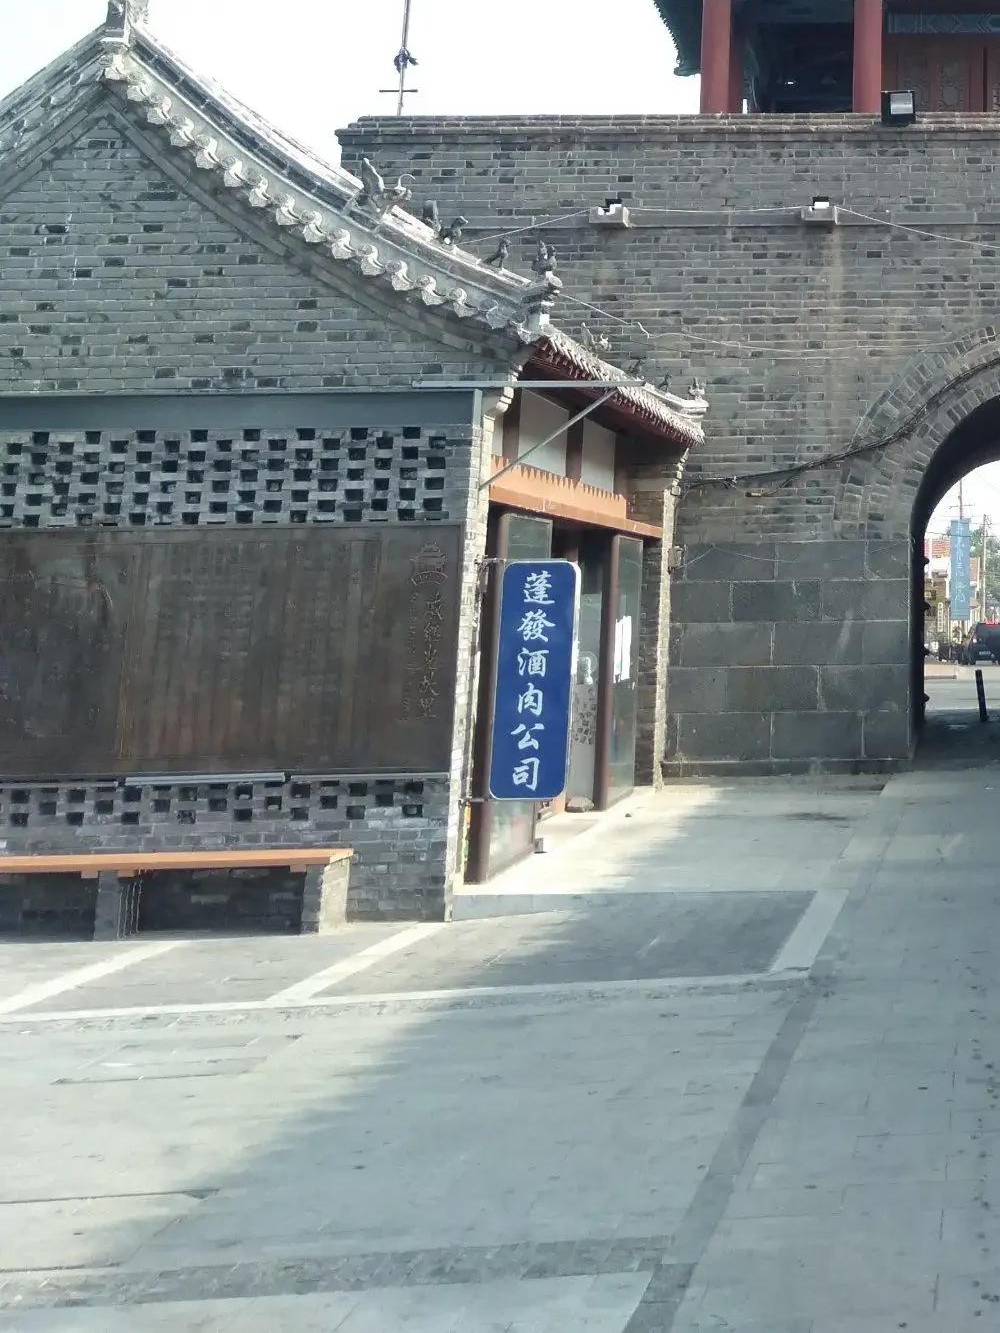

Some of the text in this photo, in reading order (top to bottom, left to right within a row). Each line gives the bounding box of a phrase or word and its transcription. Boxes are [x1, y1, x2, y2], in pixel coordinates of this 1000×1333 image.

[510, 570, 556, 792] 蓬發酒肉公司
